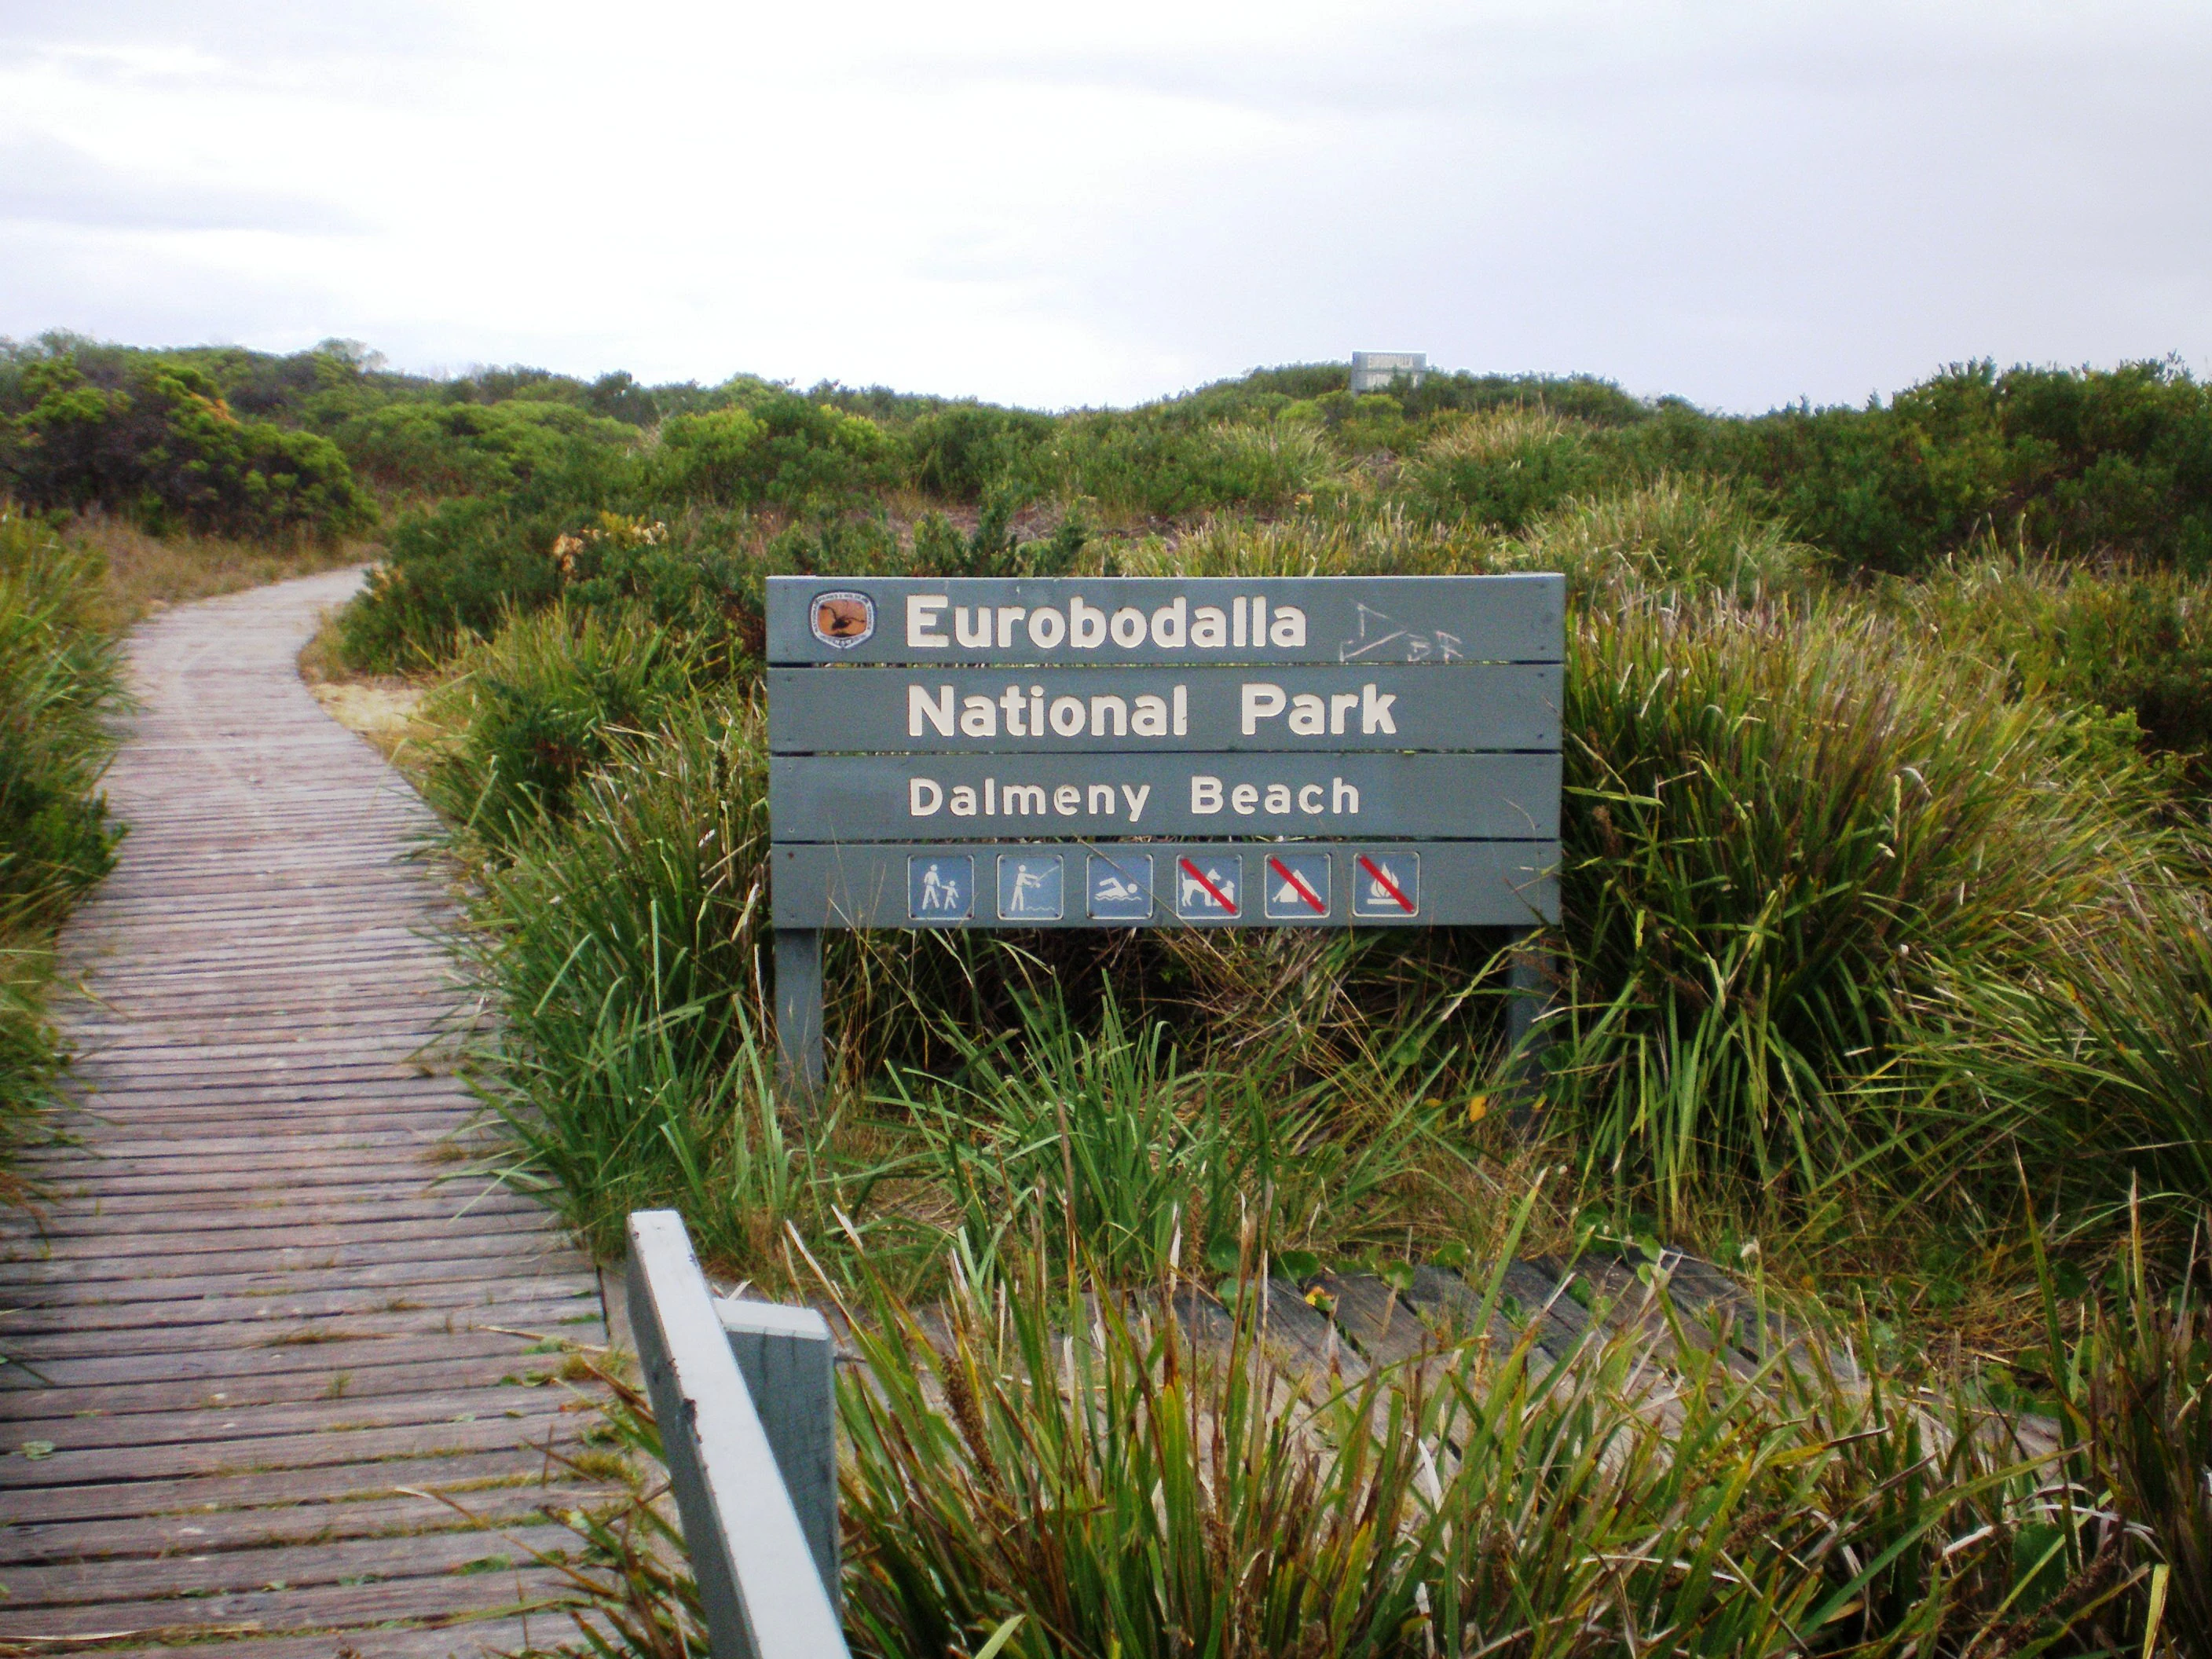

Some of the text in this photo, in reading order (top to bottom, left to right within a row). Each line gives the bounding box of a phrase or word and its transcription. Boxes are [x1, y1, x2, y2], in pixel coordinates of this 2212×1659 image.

[907, 595, 1307, 650] Eurobodalla
[909, 683, 1397, 738] National Park
[910, 776, 1360, 823] Dalmeny Beach
